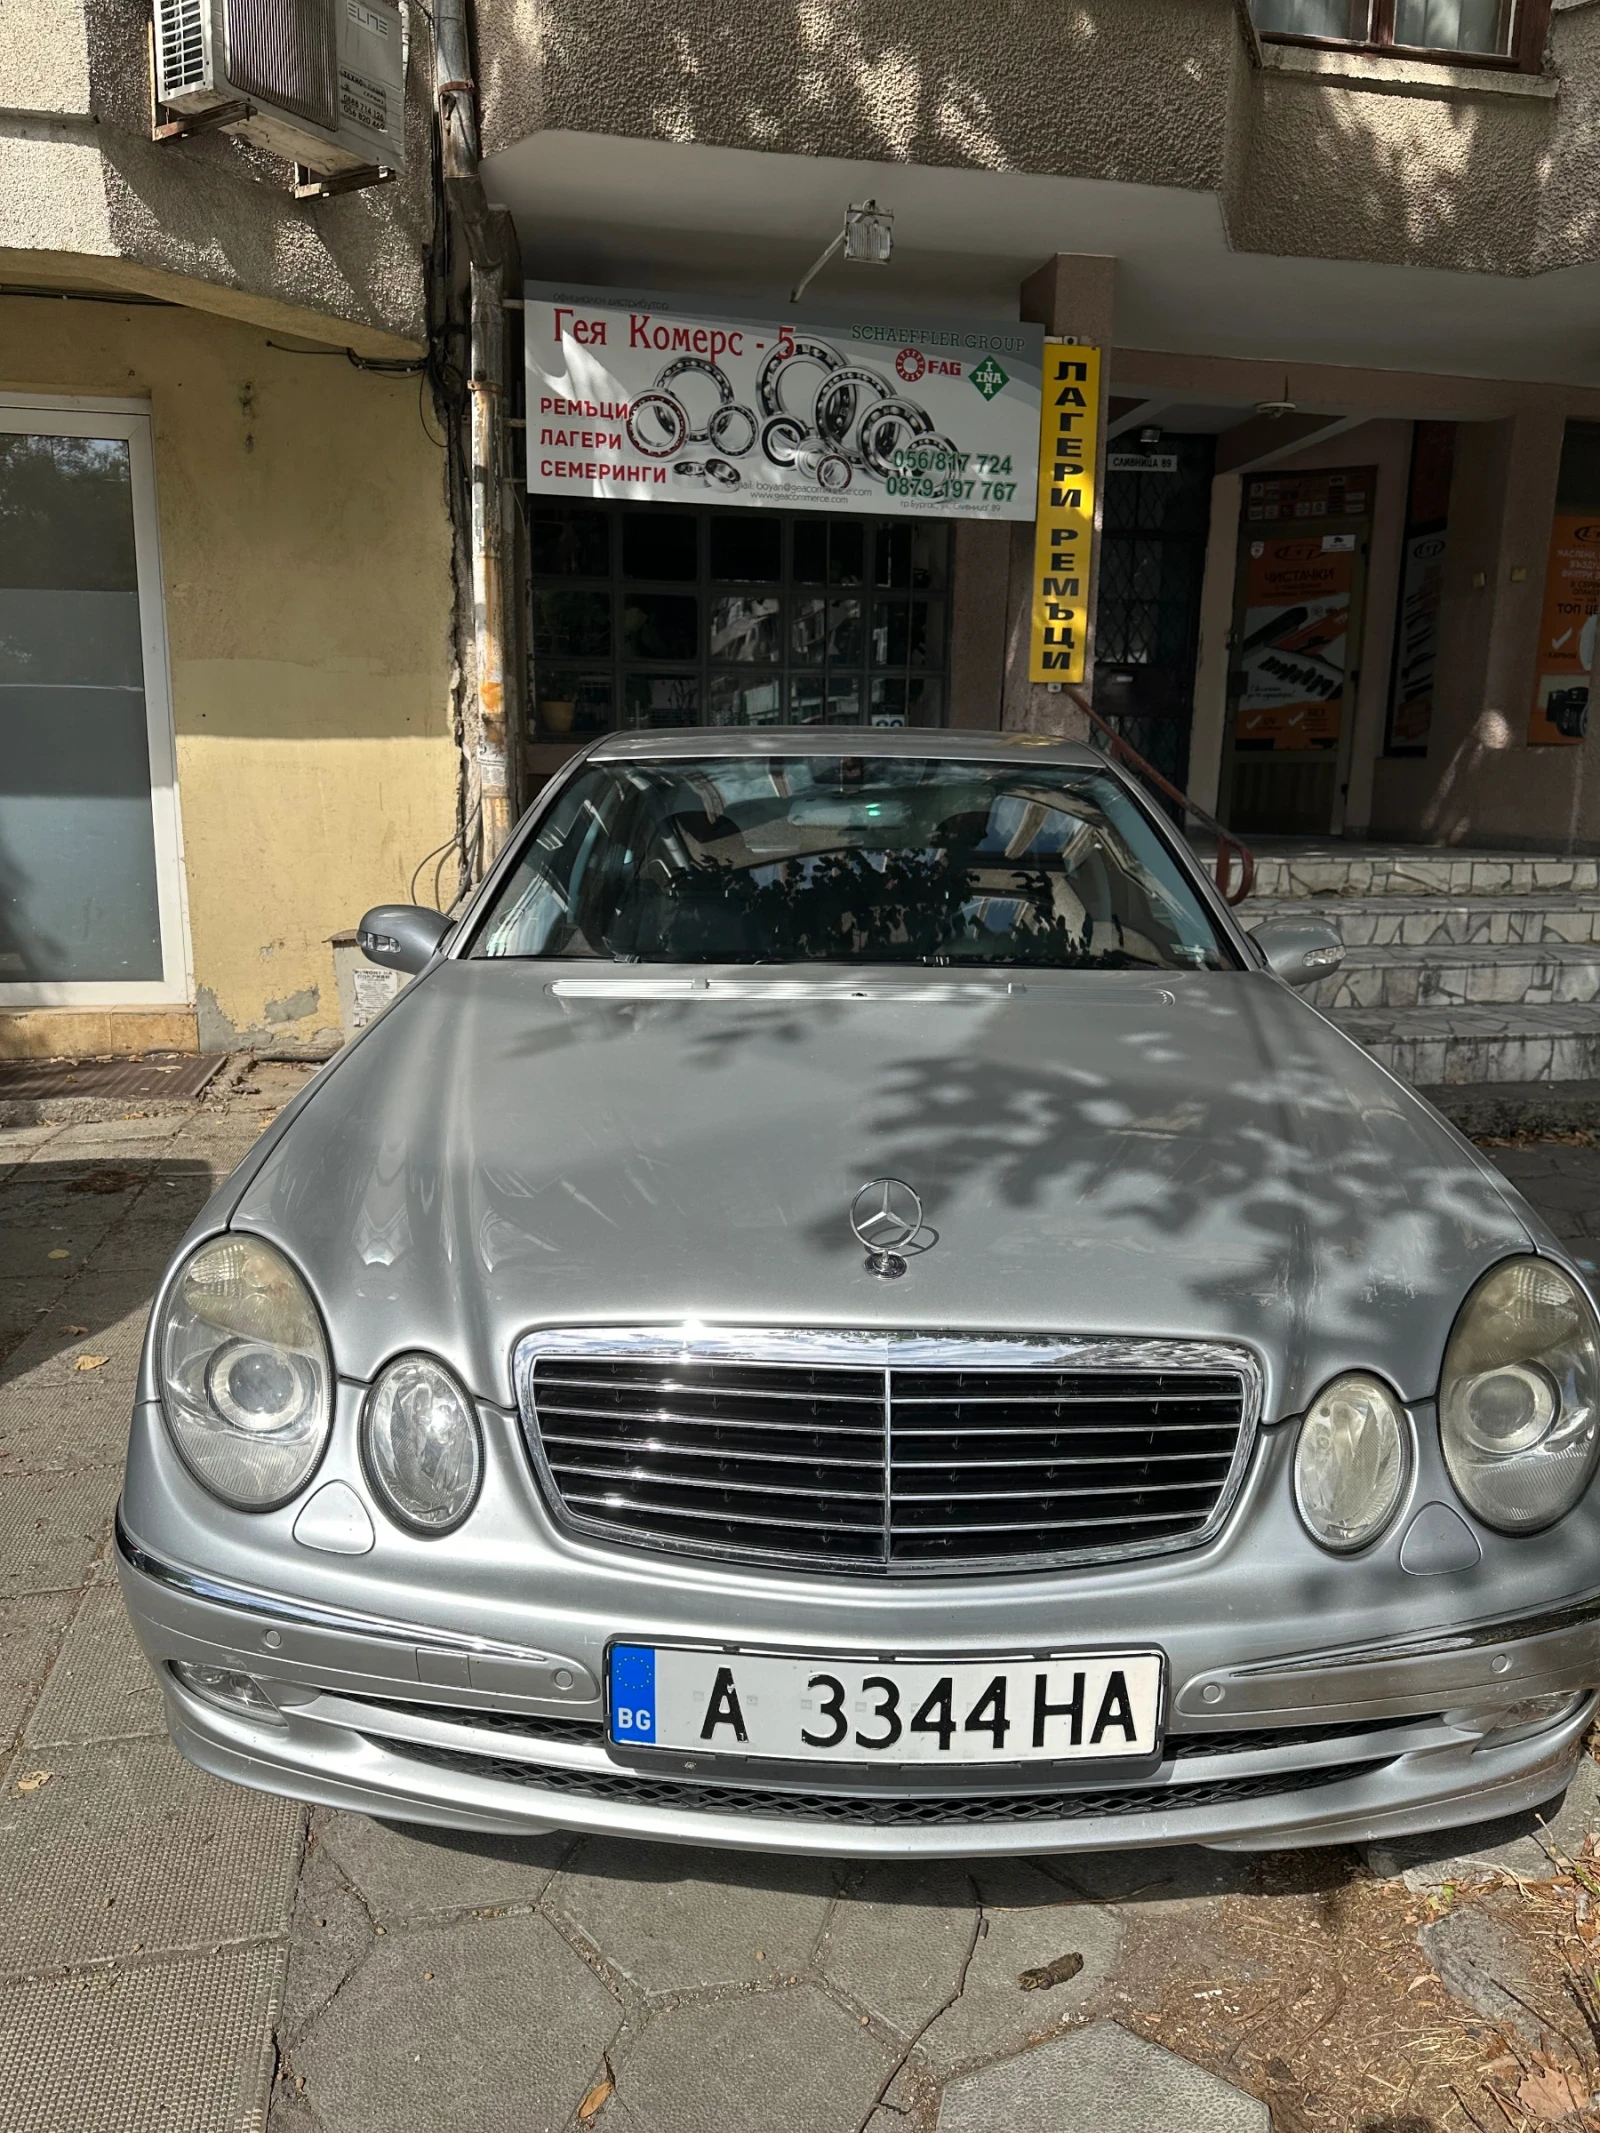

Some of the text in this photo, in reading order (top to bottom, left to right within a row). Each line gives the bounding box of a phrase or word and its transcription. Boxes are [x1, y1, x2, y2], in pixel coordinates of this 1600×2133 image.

[348, 2, 387, 36] ELITE
[343, 105, 357, 117] 056
[358, 112, 371, 125] 820
[360, 102, 372, 115] 714
[607, 297, 669, 311] дистрибутор
[553, 307, 607, 345] Гея
[629, 314, 744, 363] Комерс
[777, 325, 796, 360] 5
[852, 324, 1025, 352] SCHAEFFLER GROUP
[928, 360, 962, 376] FAG
[540, 397, 628, 420] РЕМЪЦИ
[540, 429, 622, 450] ЛАГЕРИ
[540, 460, 666, 483] СЕМЕРИНГИ
[894, 450, 1012, 475] 056/817 724
[1113, 457, 1172, 468] СЛИВНИЦА 89
[750, 491, 848, 504] www.geacommerce.com
[886, 476, 1018, 502] 0879 197 767
[1042, 361, 1087, 670] ЛАГЕРИ РЕМЪЦИ
[1570, 560, 1600, 569] ВЪЗДУ
[1264, 568, 1334, 583] ЧИСТАЧКИ
[1557, 603, 1581, 615] ТОП
[618, 1709, 652, 1731] BG
[699, 1667, 750, 1744] A
[801, 1674, 1010, 1752] 3344
